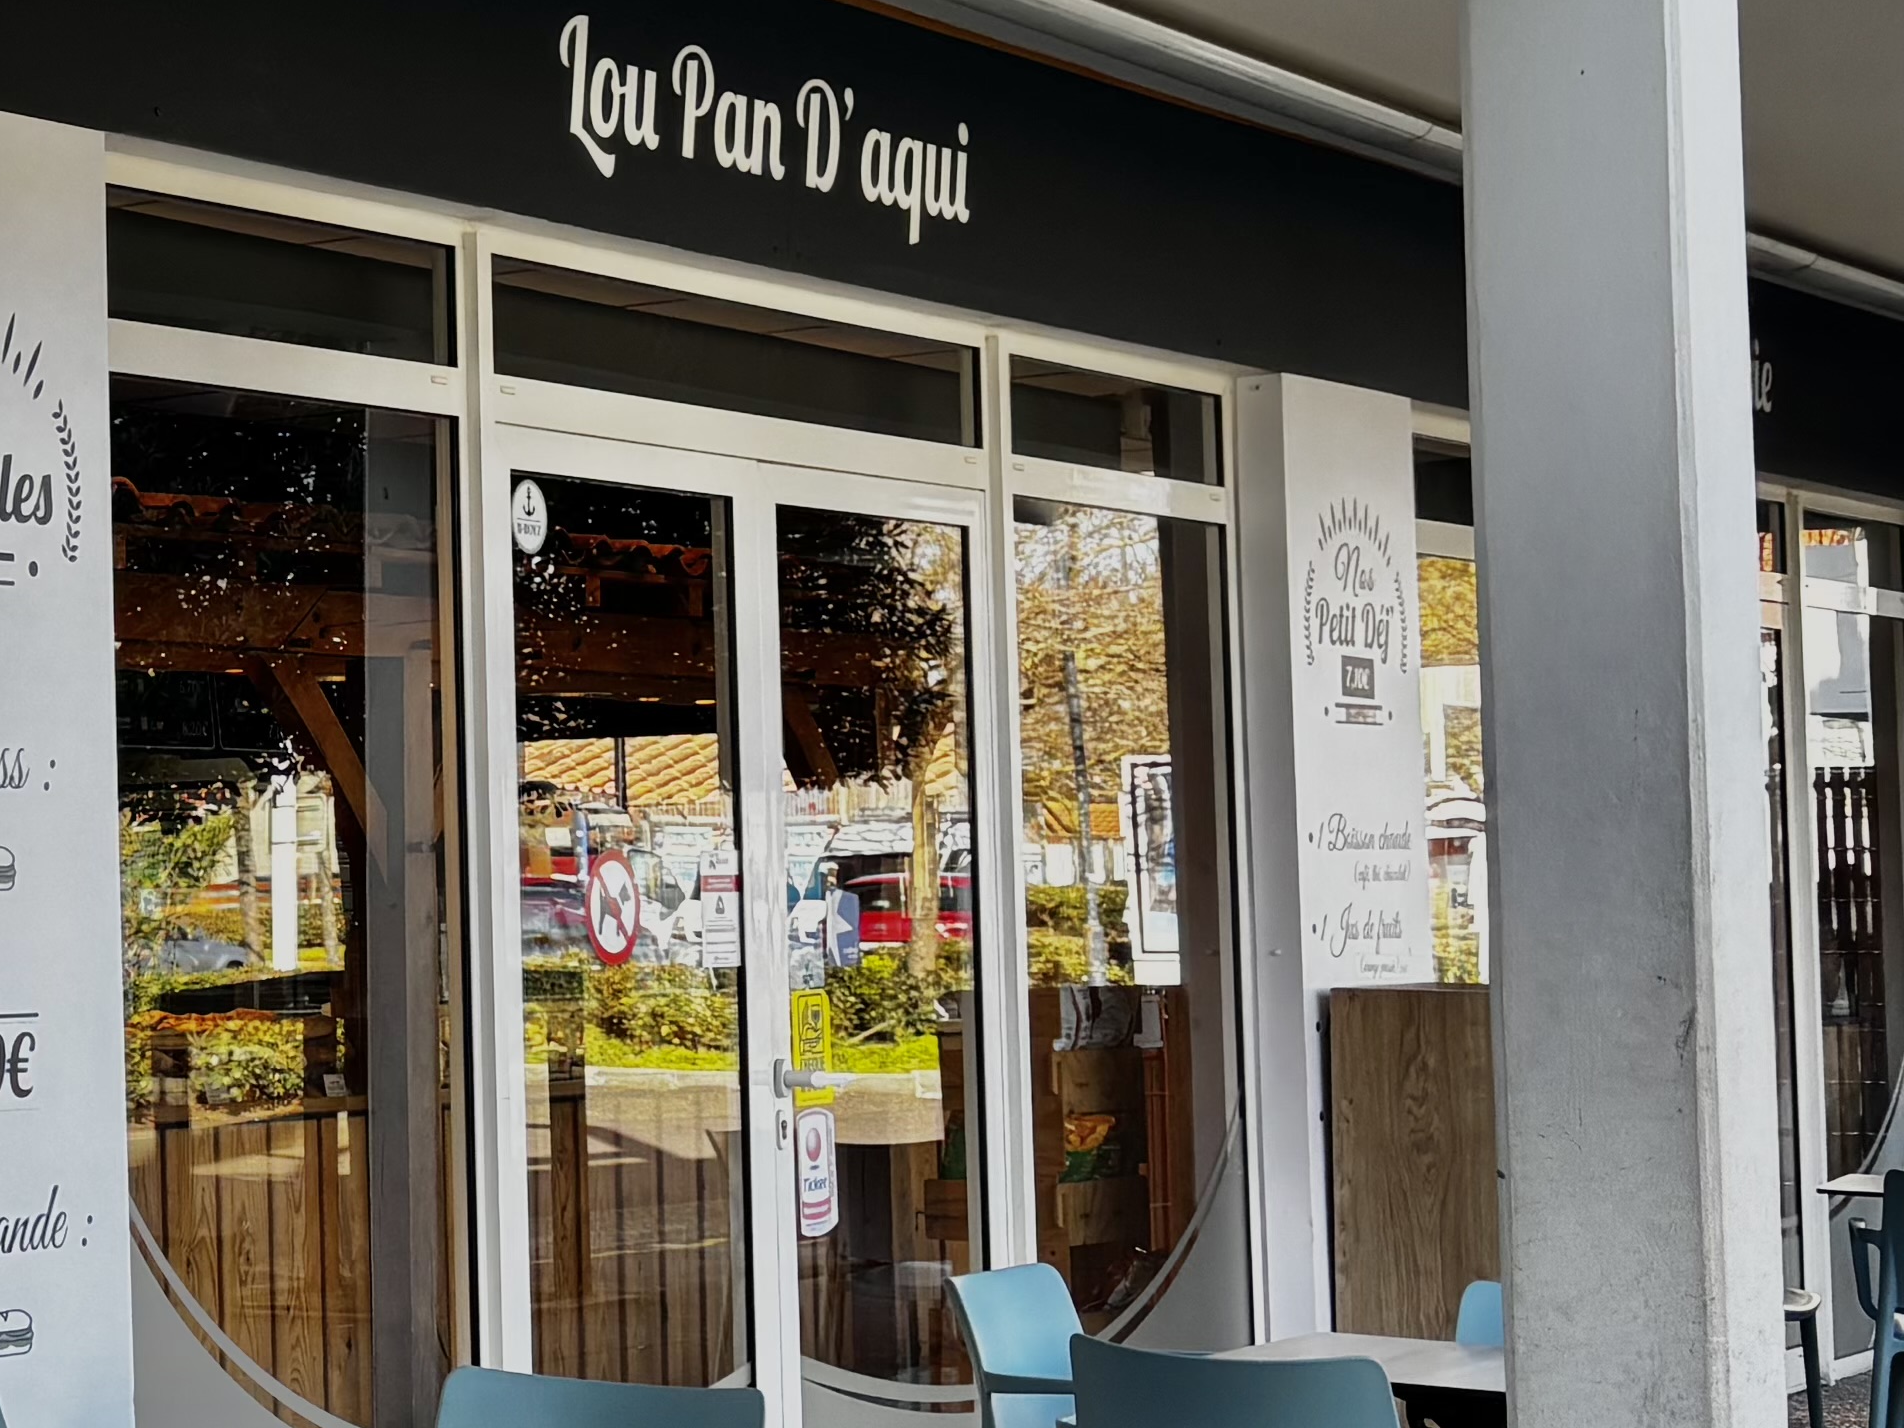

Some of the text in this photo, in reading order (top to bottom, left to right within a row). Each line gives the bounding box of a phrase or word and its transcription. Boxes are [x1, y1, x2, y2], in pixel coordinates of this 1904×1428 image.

[559, 15, 660, 178] Lou
[672, 44, 785, 181] Pan
[1335, 542, 1374, 597] Nos
[1315, 597, 1355, 647] Petit
